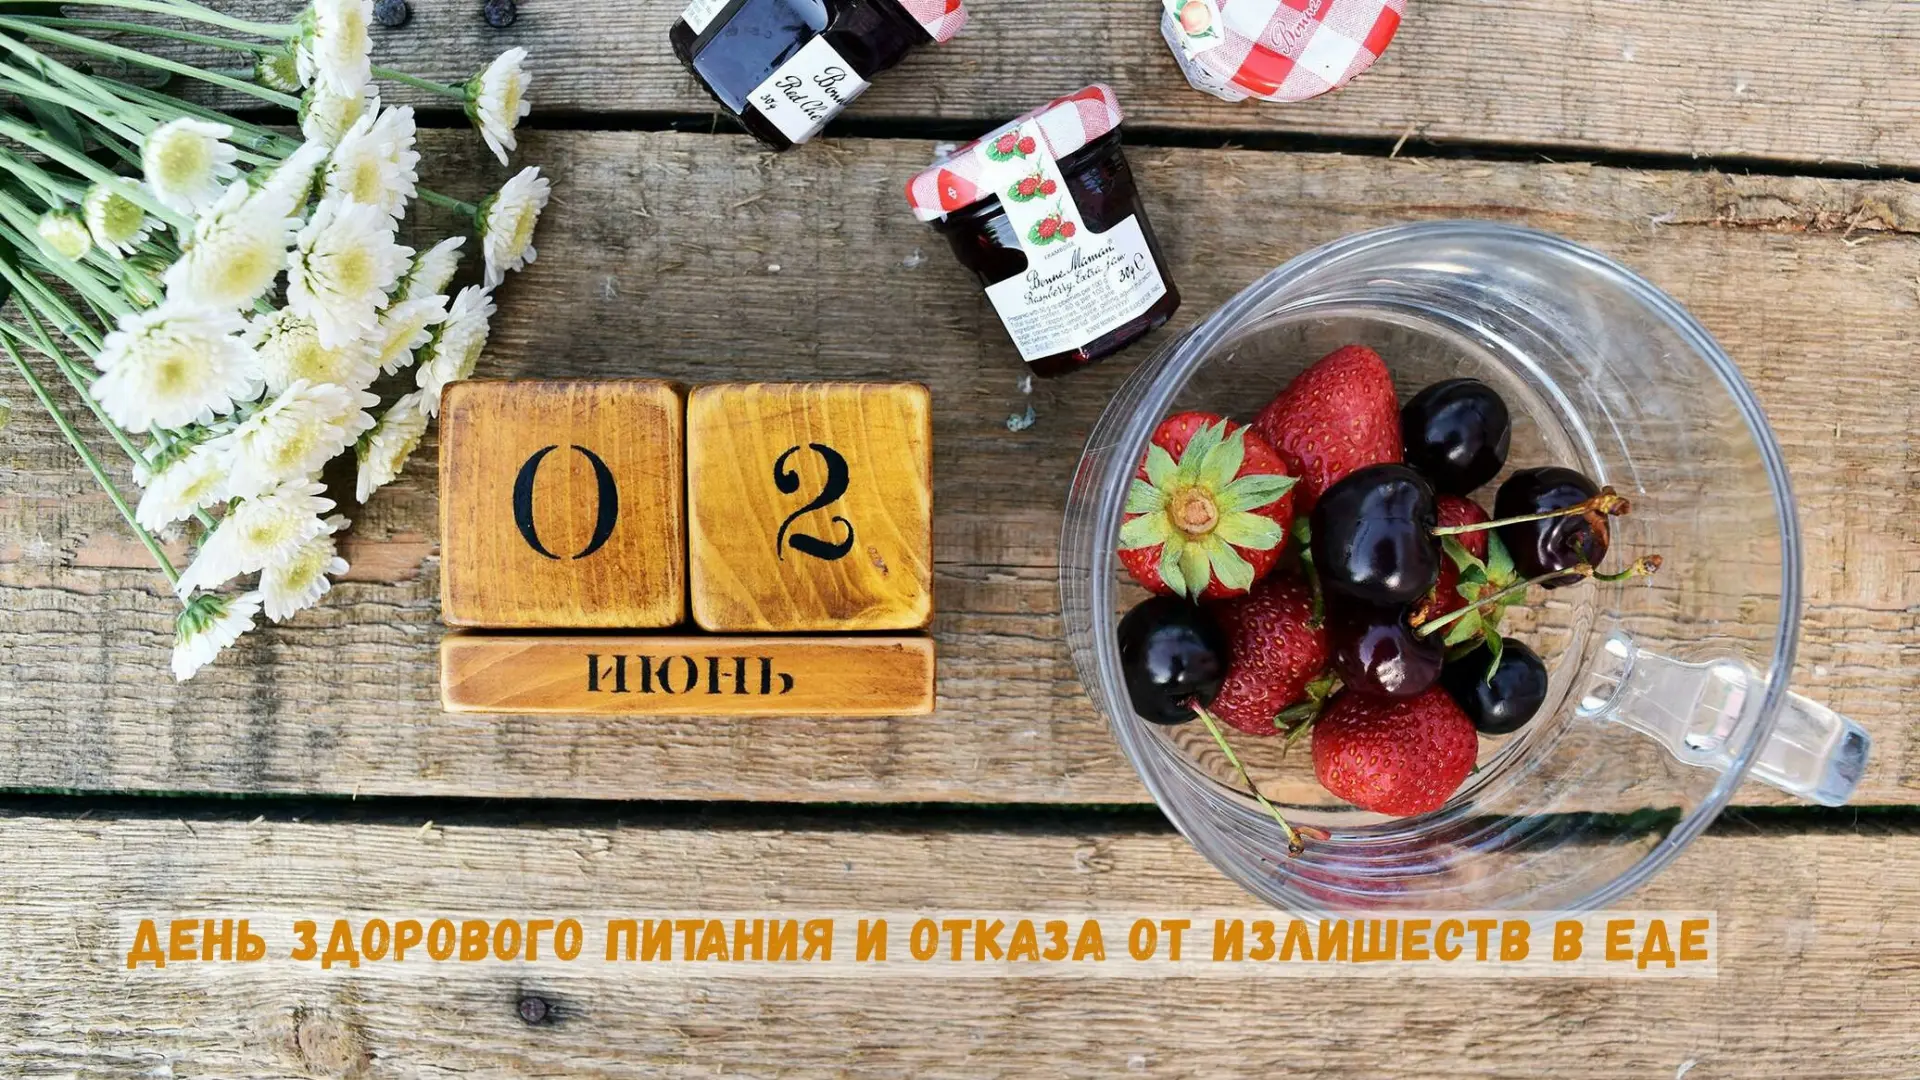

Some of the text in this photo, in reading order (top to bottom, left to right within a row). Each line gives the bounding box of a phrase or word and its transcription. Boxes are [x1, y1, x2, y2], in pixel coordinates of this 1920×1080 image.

[775, 74, 802, 105] Red
[1025, 267, 1066, 291] Bonne
[587, 654, 793, 695] ИЮНЬ
